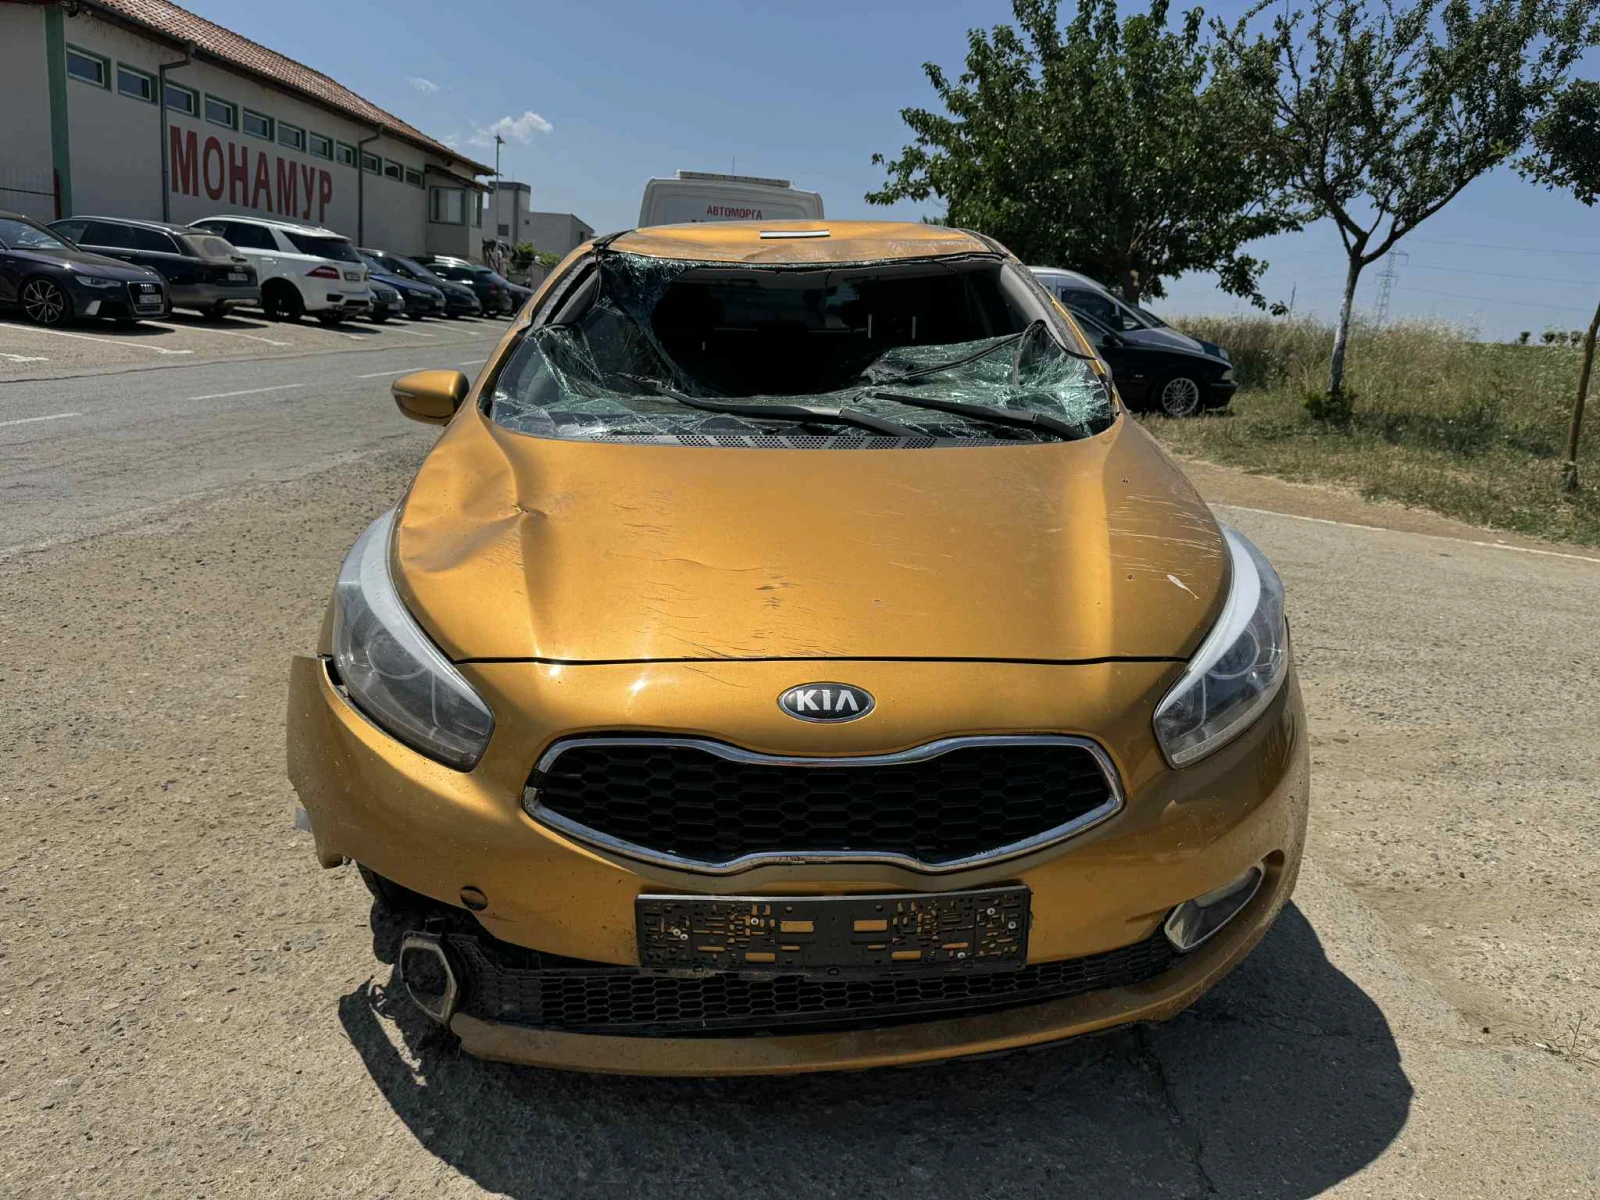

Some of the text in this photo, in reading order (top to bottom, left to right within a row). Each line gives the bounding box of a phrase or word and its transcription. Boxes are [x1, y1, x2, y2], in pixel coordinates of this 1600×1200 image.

[170, 125, 333, 223] МОНАМУР
[706, 205, 763, 220] АВТОМОРГА
[795, 689, 859, 711] KIA
